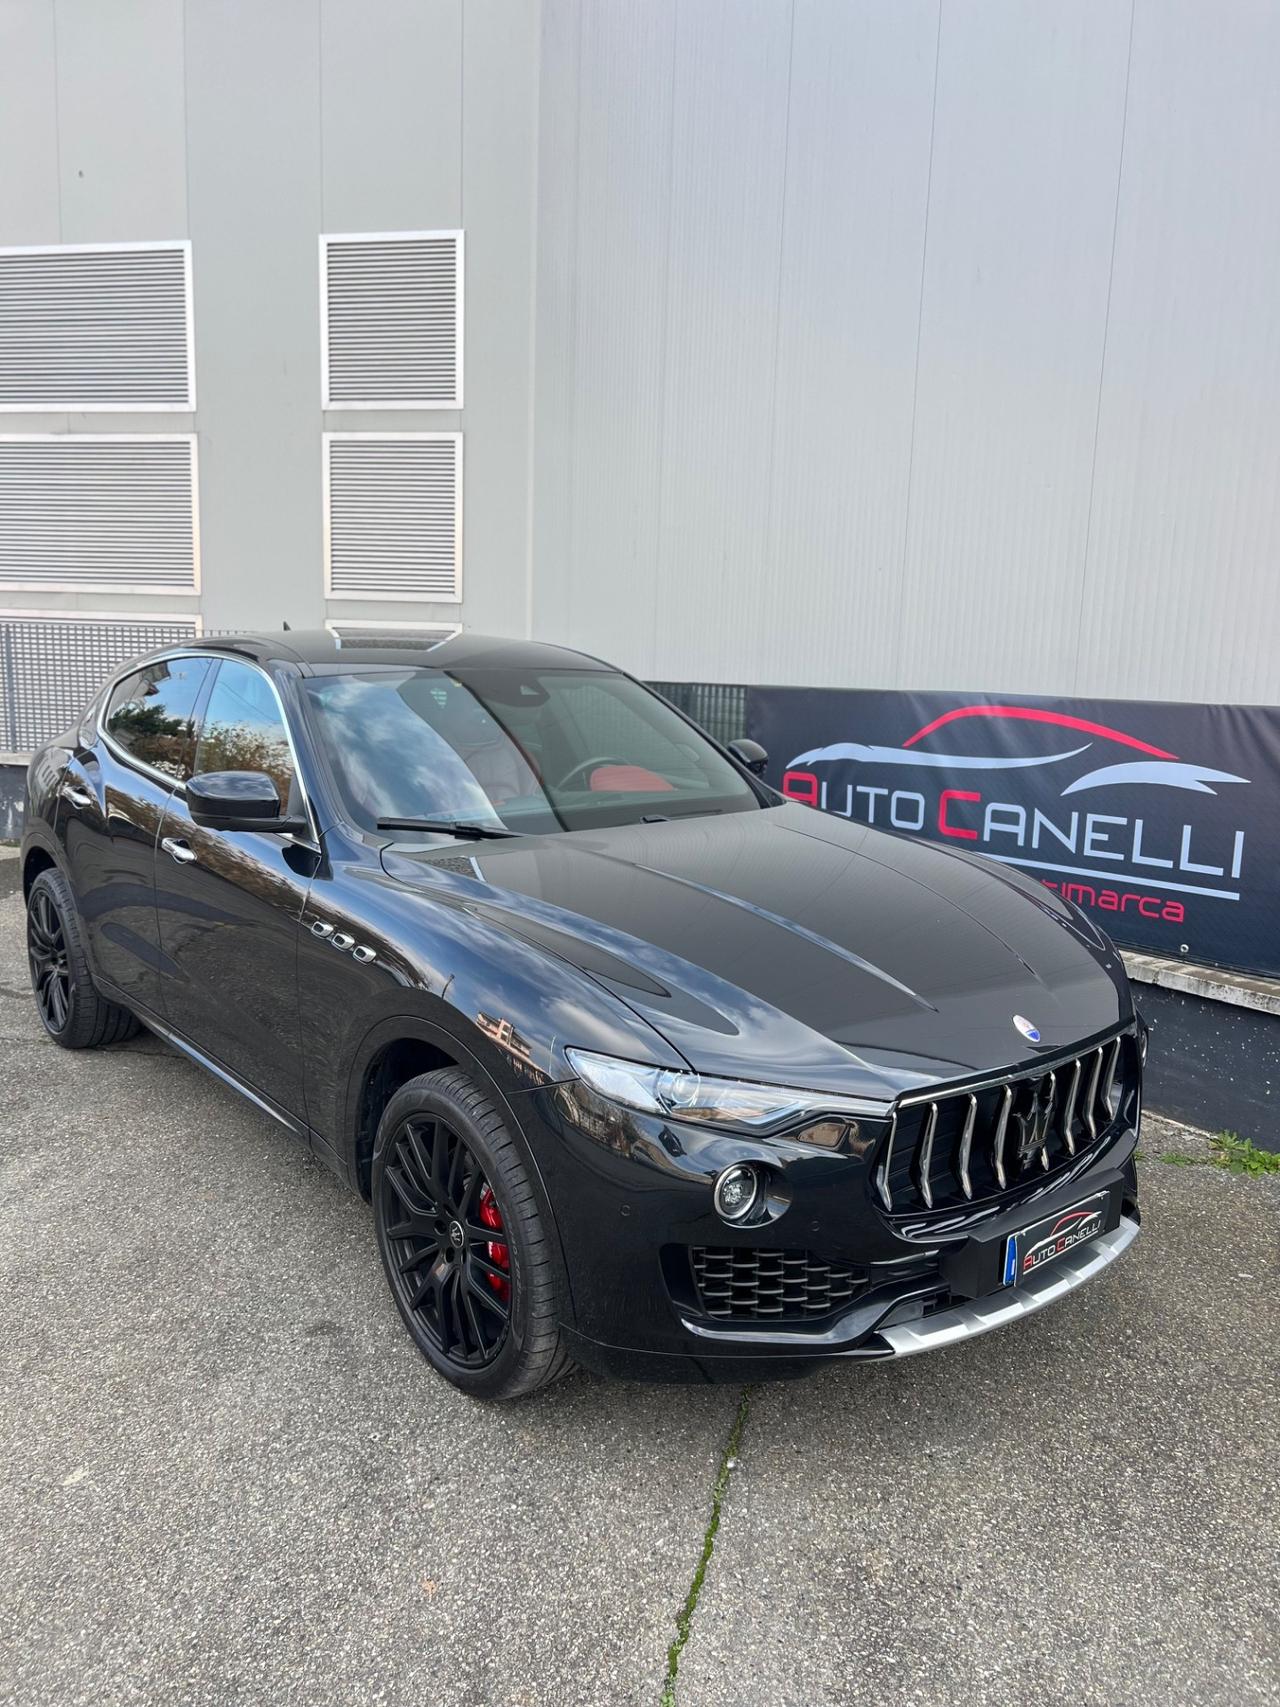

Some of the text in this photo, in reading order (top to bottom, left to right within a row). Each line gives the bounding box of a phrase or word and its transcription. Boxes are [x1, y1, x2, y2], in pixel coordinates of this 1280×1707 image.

[783, 771, 1244, 878] AUTO CANELLI
[1023, 1220, 1101, 1270] AUTO CANELLI
